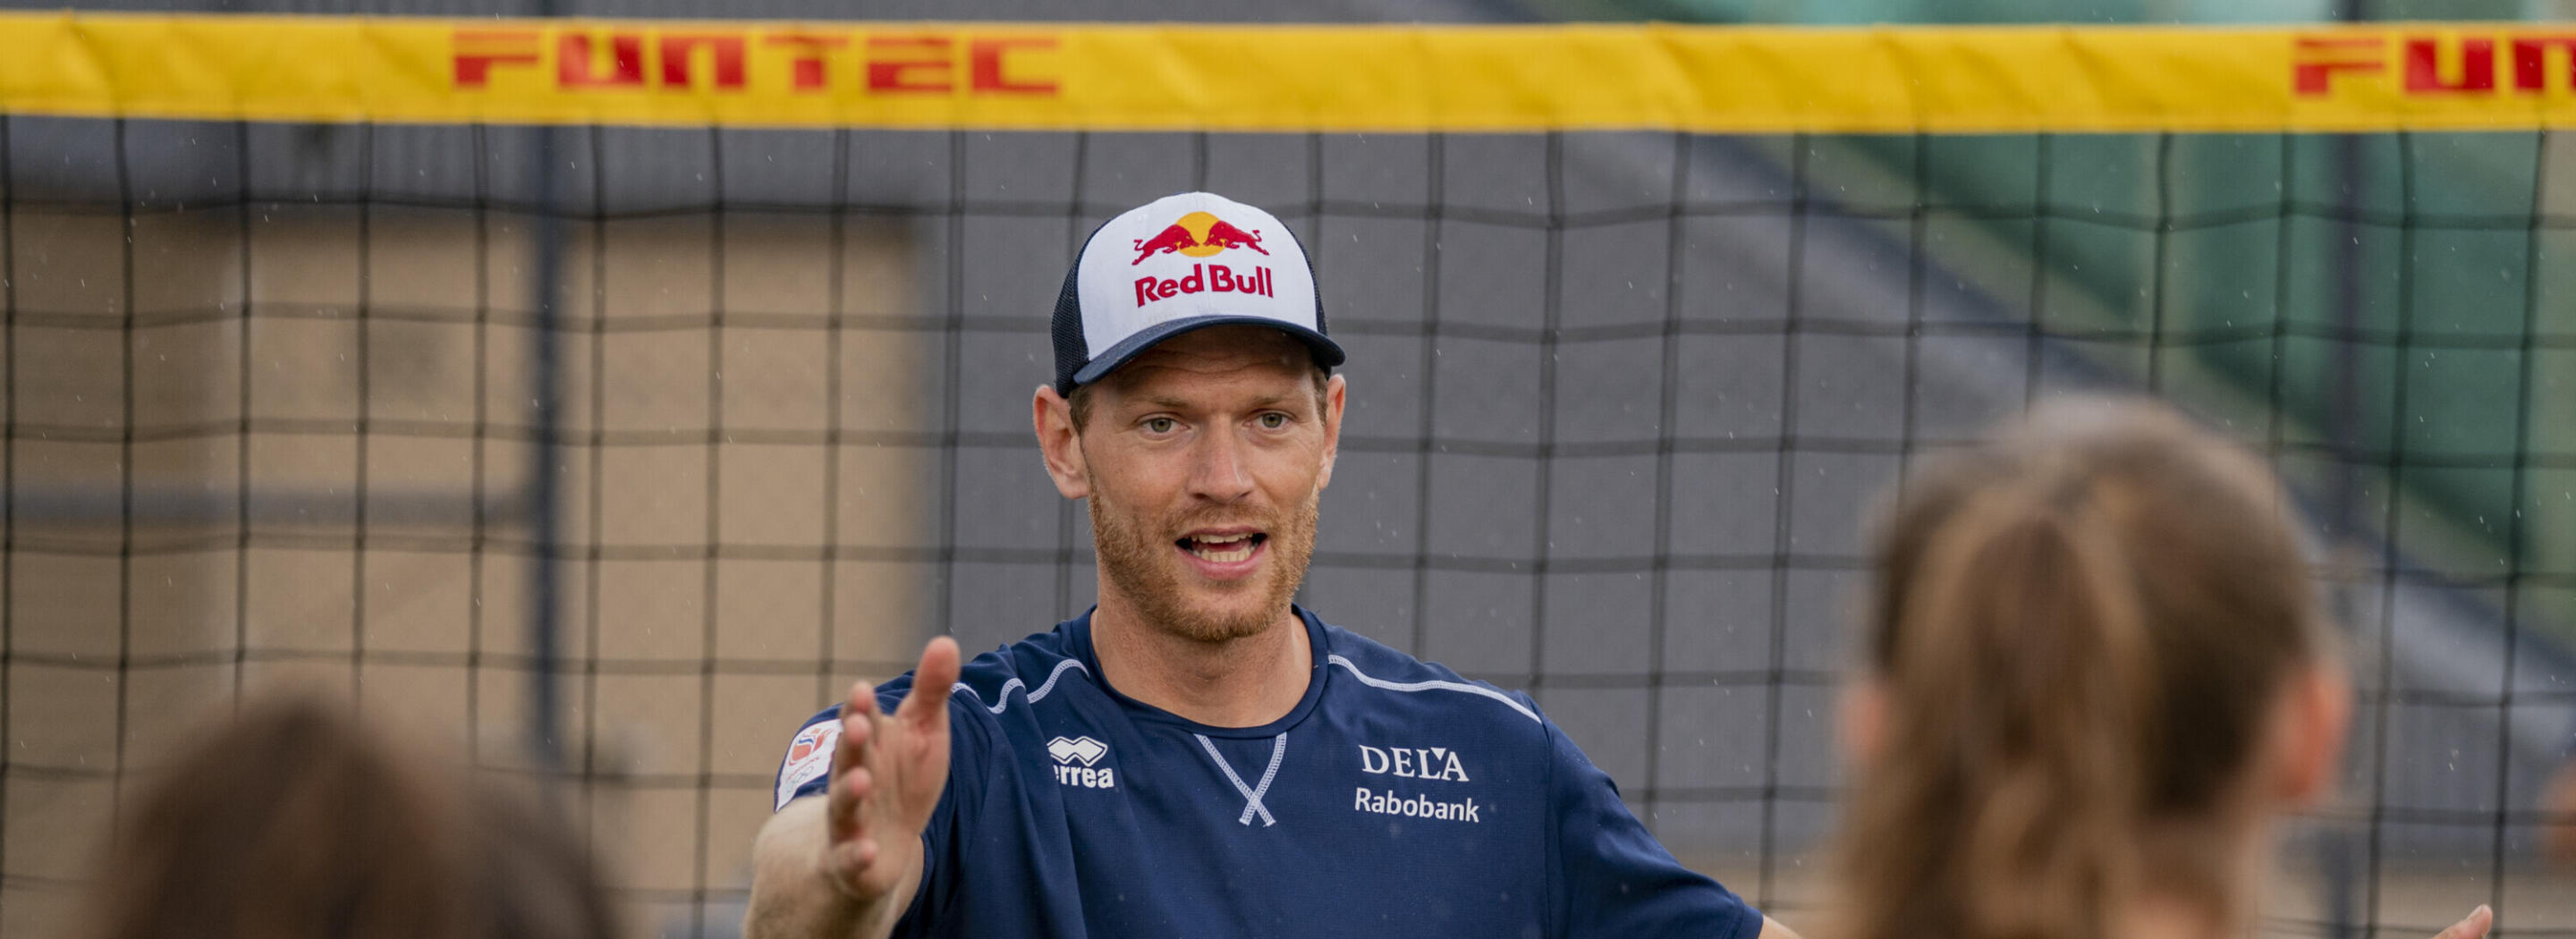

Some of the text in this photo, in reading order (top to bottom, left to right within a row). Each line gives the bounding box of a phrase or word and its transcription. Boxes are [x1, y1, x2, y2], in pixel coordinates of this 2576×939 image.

[452, 31, 1063, 96] FUNTEC
[1134, 263, 1274, 308] Red Bull
[1359, 744, 1470, 782] DELA
[1354, 787, 1479, 823] Rabobank
